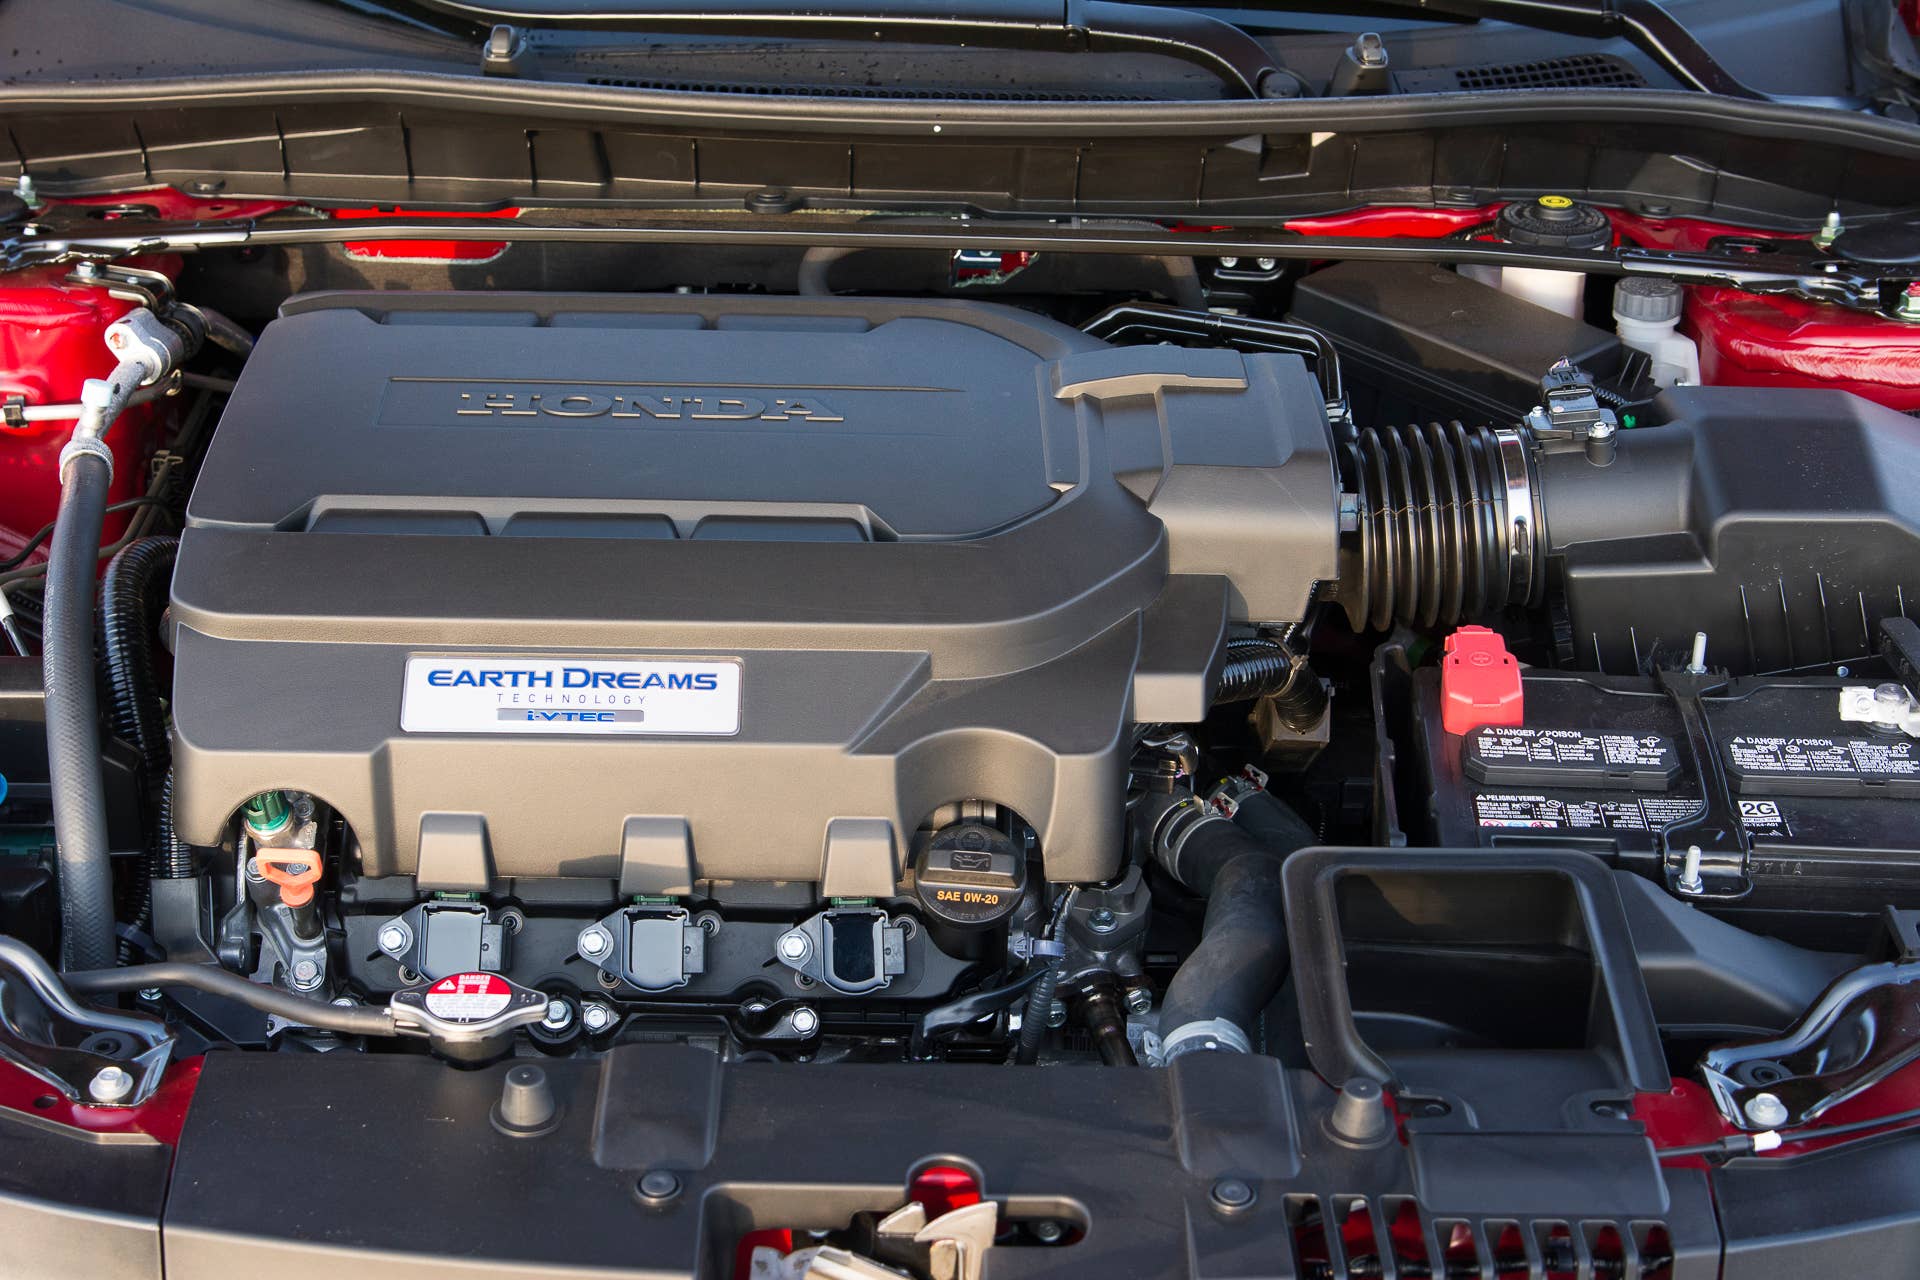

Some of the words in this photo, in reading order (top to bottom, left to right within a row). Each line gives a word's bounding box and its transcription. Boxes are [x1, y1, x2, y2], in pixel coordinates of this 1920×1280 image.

[456, 391, 844, 421] HONDA
[427, 669, 552, 688] EARTH
[563, 668, 718, 690] DREAMS
[496, 693, 646, 704] TECHNOLOGY
[527, 710, 615, 722] i-VTEC
[1496, 728, 1535, 737] DANGER
[1545, 730, 1582, 738] POISON
[1747, 737, 1786, 745] DANGER
[1742, 803, 1776, 815] 2G
[937, 891, 961, 901] SAE
[964, 893, 999, 904] 0W-20
